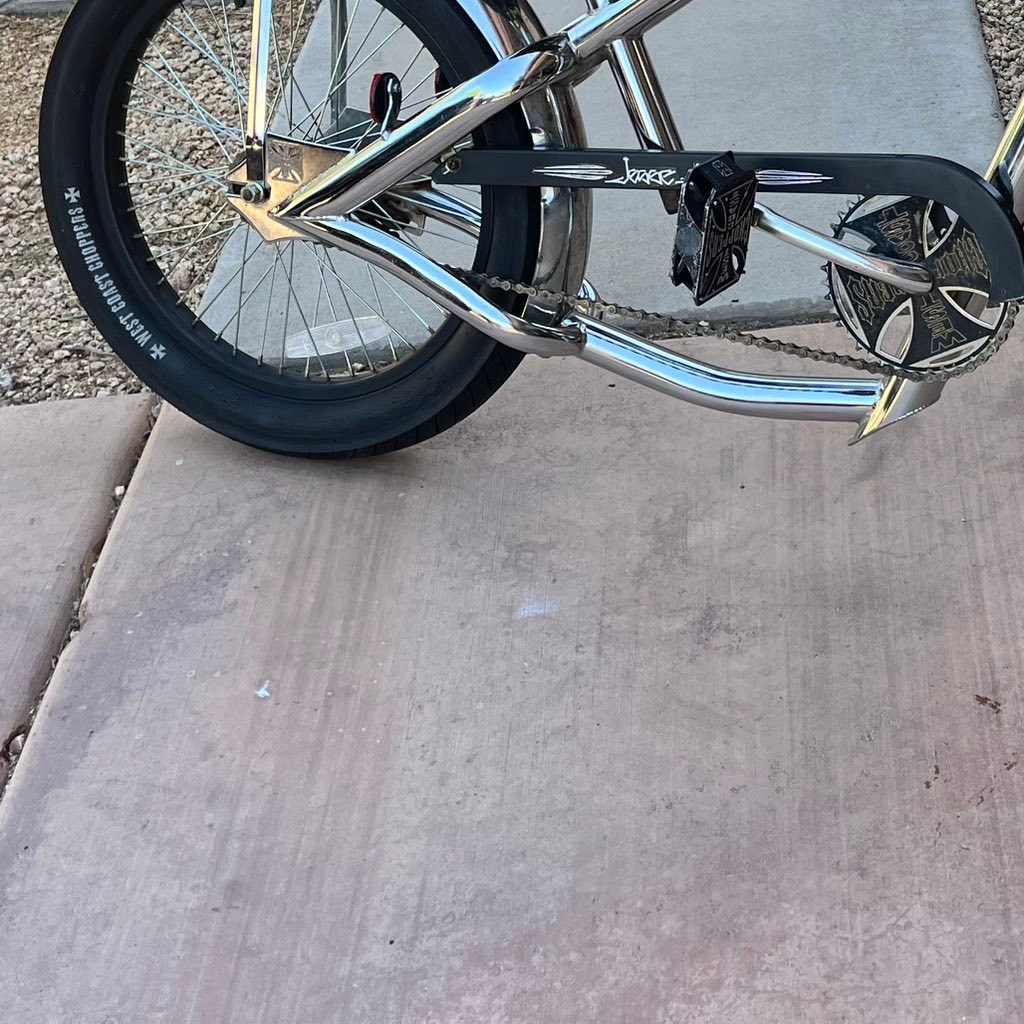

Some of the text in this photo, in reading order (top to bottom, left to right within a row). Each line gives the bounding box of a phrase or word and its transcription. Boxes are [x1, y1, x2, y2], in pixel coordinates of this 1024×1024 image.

[67, 207, 153, 348] WEST COAST CHOPPERS
[920, 292, 968, 354] WEST
